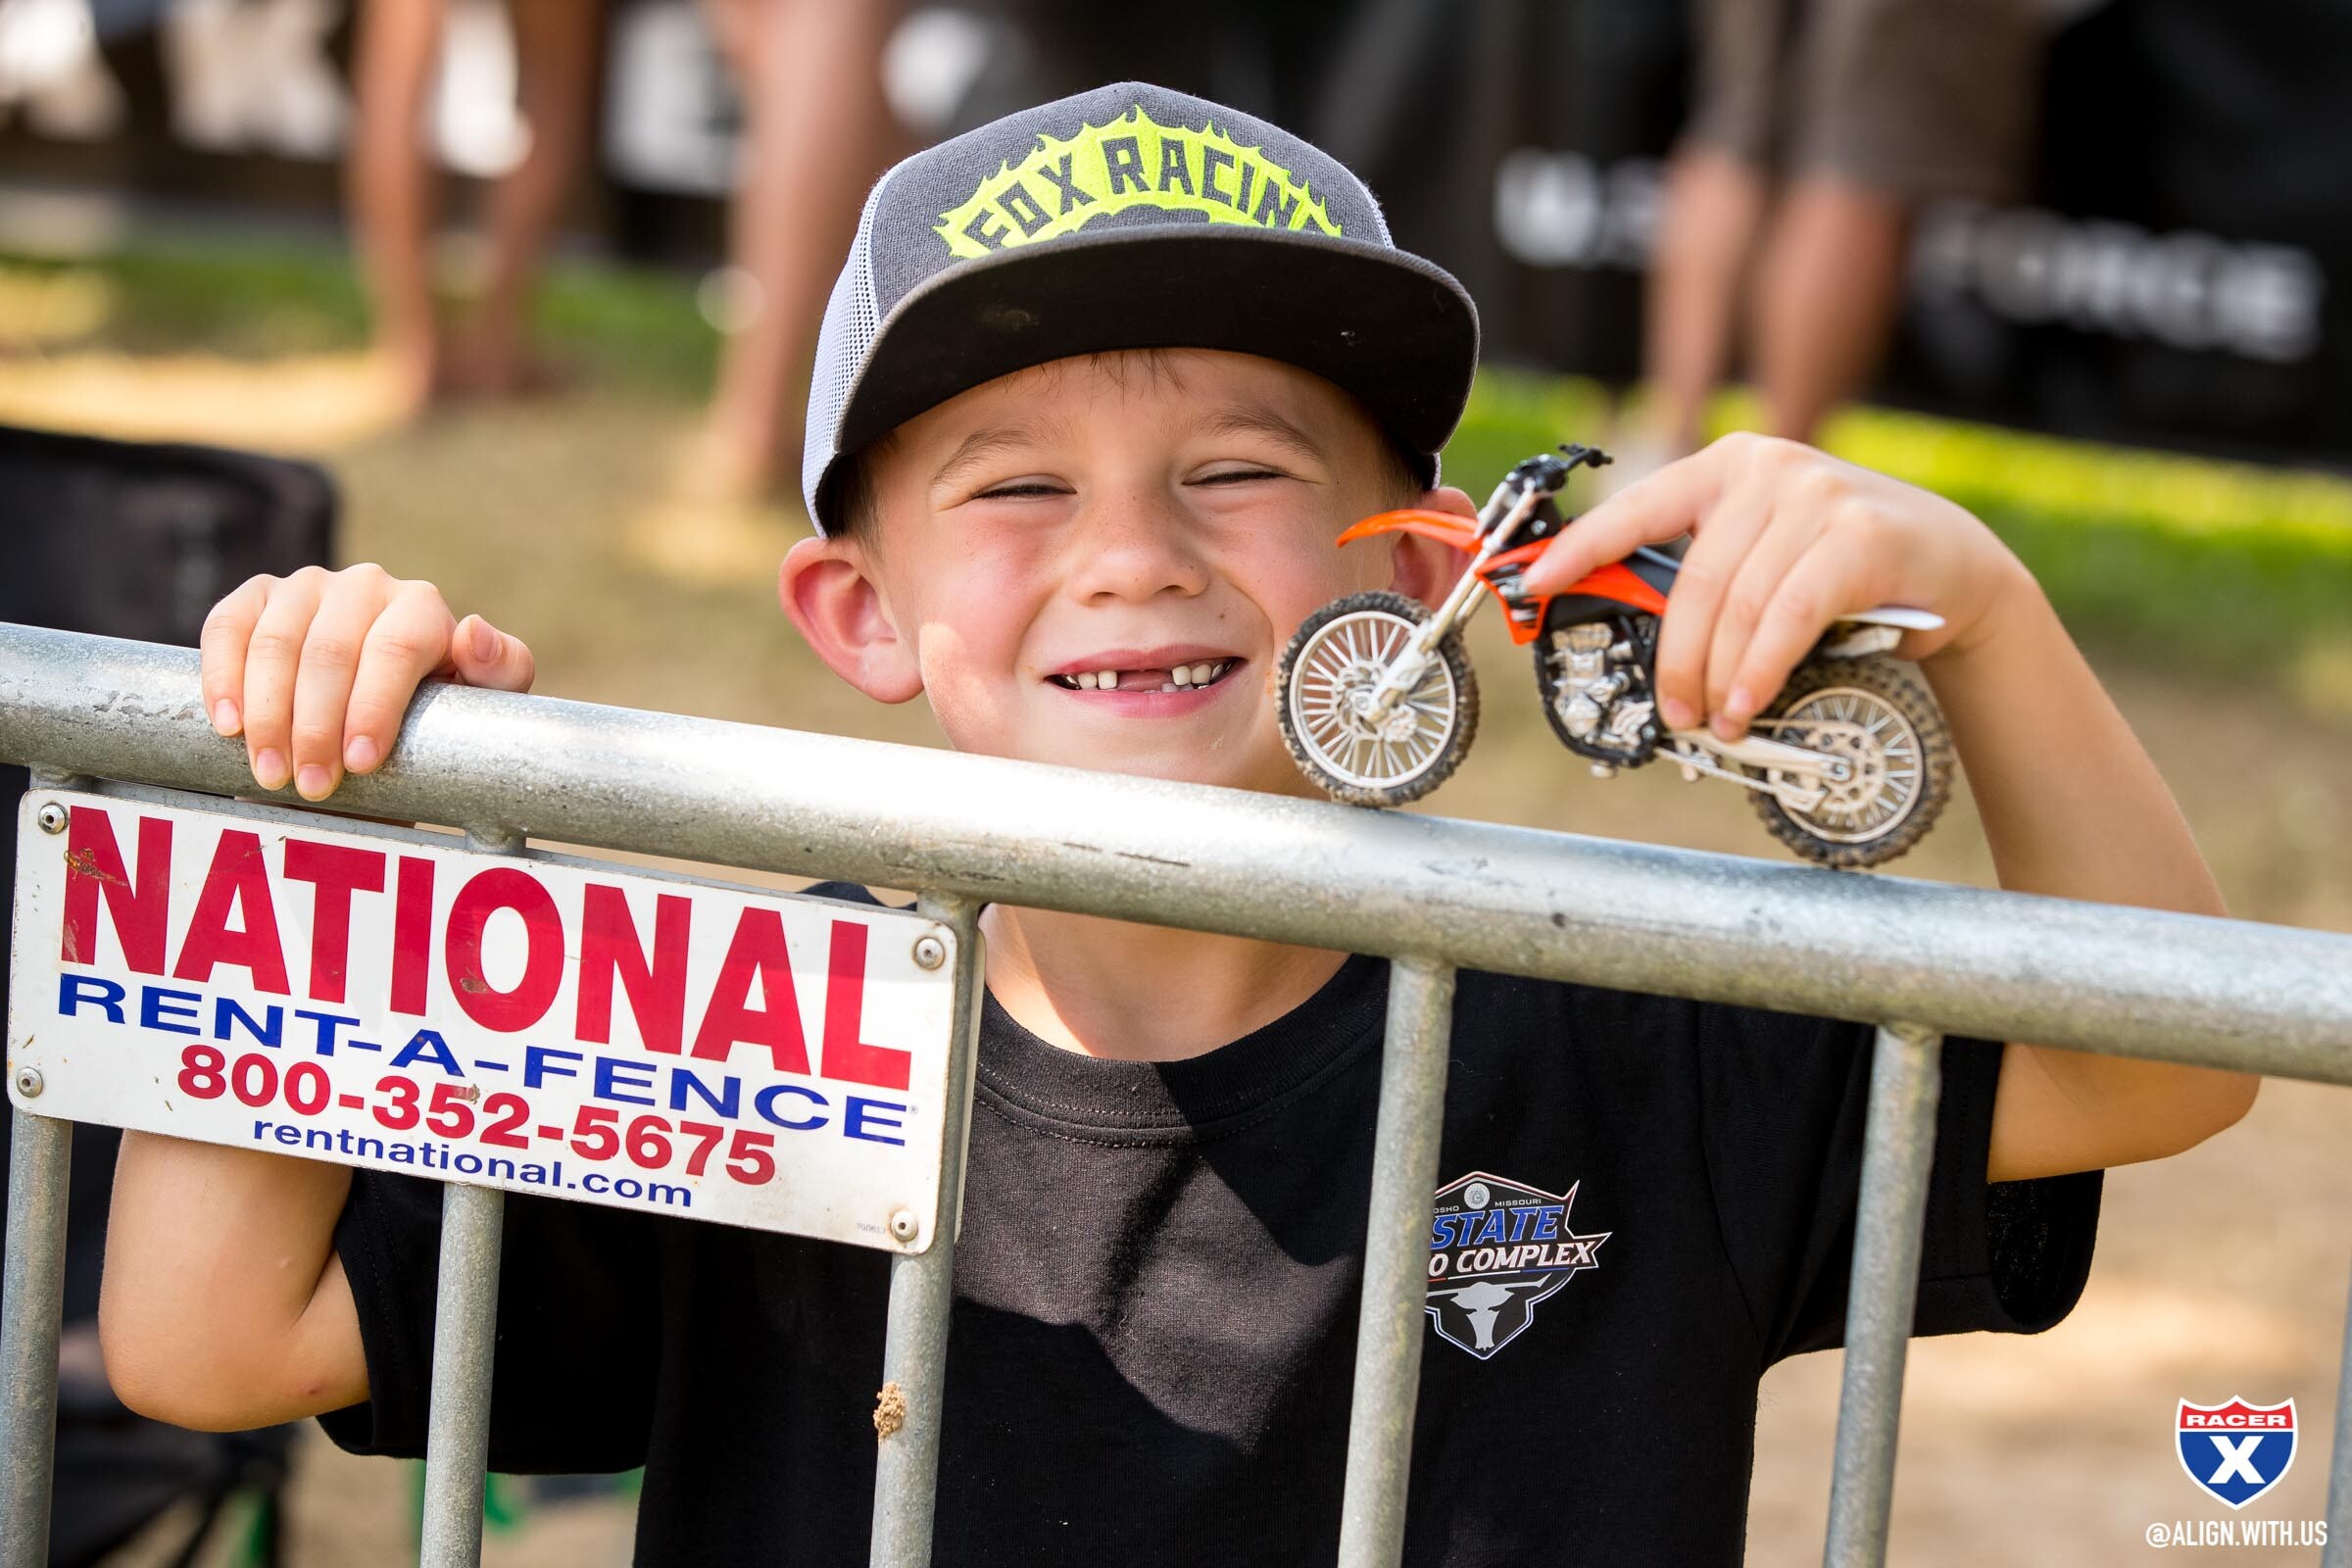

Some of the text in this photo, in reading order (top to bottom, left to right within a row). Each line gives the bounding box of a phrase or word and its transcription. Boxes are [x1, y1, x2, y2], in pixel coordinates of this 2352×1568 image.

[962, 136, 1327, 250] FOX RACIN
[61, 805, 912, 1091] NATIONAL
[58, 973, 907, 1146] RENT-A-FENCE
[177, 1044, 776, 1186] 800-352-5675
[254, 1119, 692, 1207] rentnational.com
[1430, 1205, 1564, 1250] STATE
[1434, 1199, 1542, 1214] OSHO MISSOURI
[1456, 1241, 1595, 1273] COMPLEX
